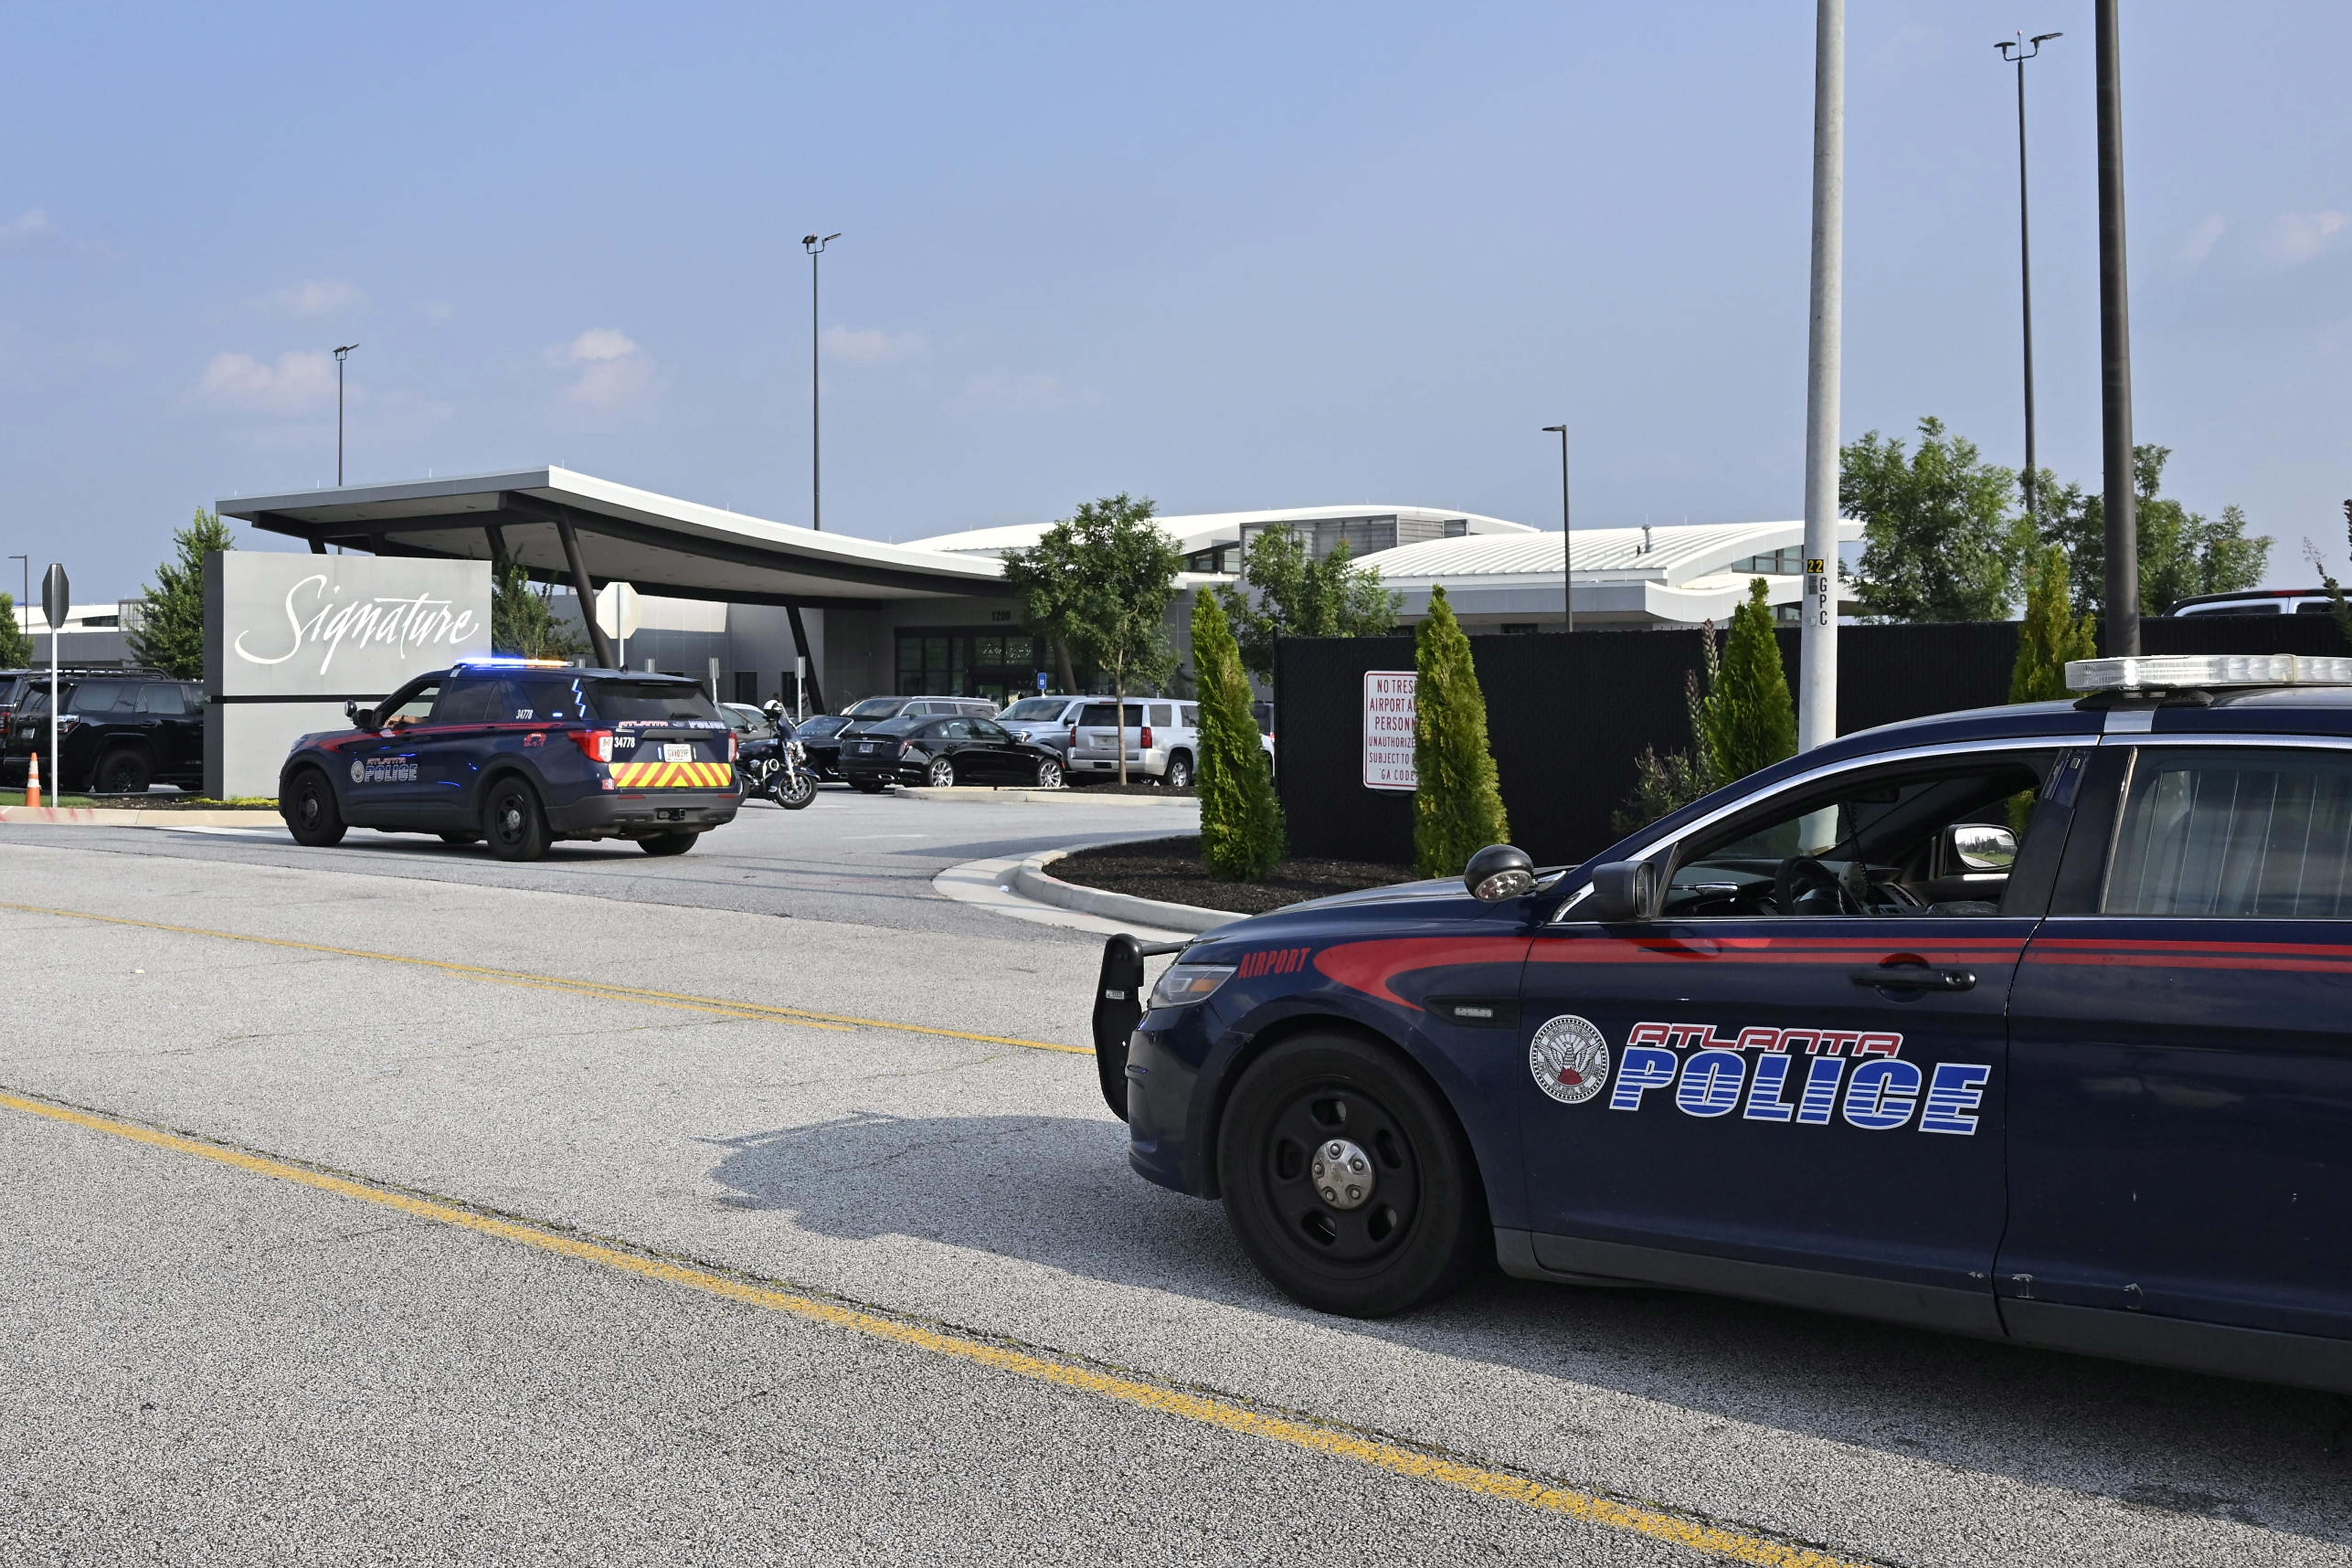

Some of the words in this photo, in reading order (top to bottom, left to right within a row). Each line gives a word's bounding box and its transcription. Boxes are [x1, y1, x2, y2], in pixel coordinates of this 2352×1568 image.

[1808, 560, 1823, 572] 22
[235, 575, 479, 675] Signature
[1377, 679, 1388, 693] NO
[1369, 698, 1405, 712] AIRPORT
[516, 709, 533, 719] 34778
[614, 737, 635, 748] 34778
[1368, 736, 1416, 748] UNAUTHORIZE
[1369, 752, 1399, 764] SUBJECT
[1401, 753, 1409, 764] TO
[365, 764, 418, 782] POLICE
[1381, 769, 1391, 780] GA
[1394, 769, 1415, 781] CODE
[1238, 947, 1312, 979] AIRPORT
[1626, 1022, 1904, 1058] ATLANTA
[1609, 1046, 1992, 1136] POLICE
